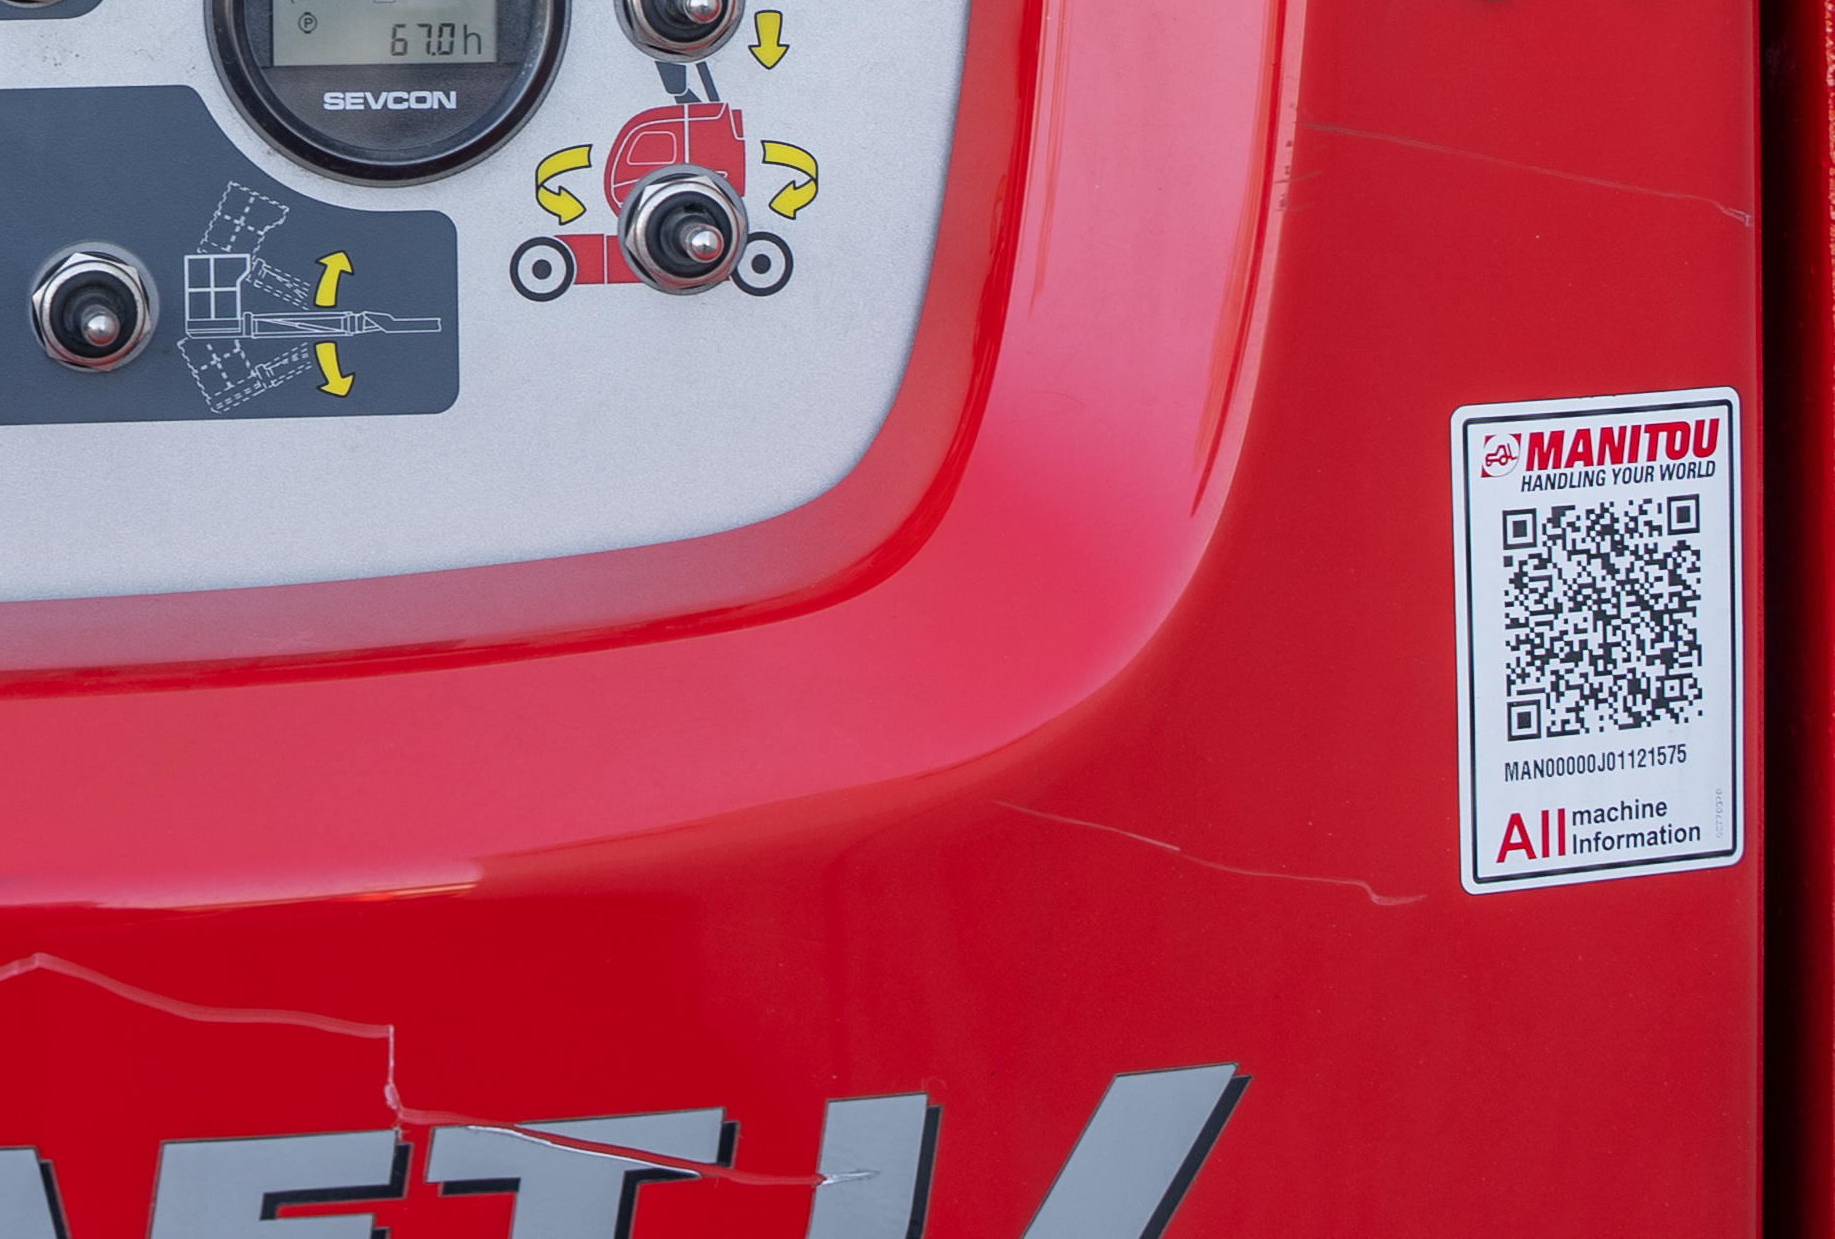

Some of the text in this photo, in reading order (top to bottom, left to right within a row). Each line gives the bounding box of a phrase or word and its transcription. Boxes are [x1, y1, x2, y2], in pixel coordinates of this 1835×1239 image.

[322, 90, 457, 111] SEVCON
[1525, 418, 1720, 472] MANITOU
[1521, 460, 1715, 493] HANDLING YOUR WORLD
[1504, 743, 1687, 782] MAN00000J01121575
[1571, 798, 1668, 827] machine
[1495, 807, 1566, 864] All
[1572, 823, 1701, 855] Information
